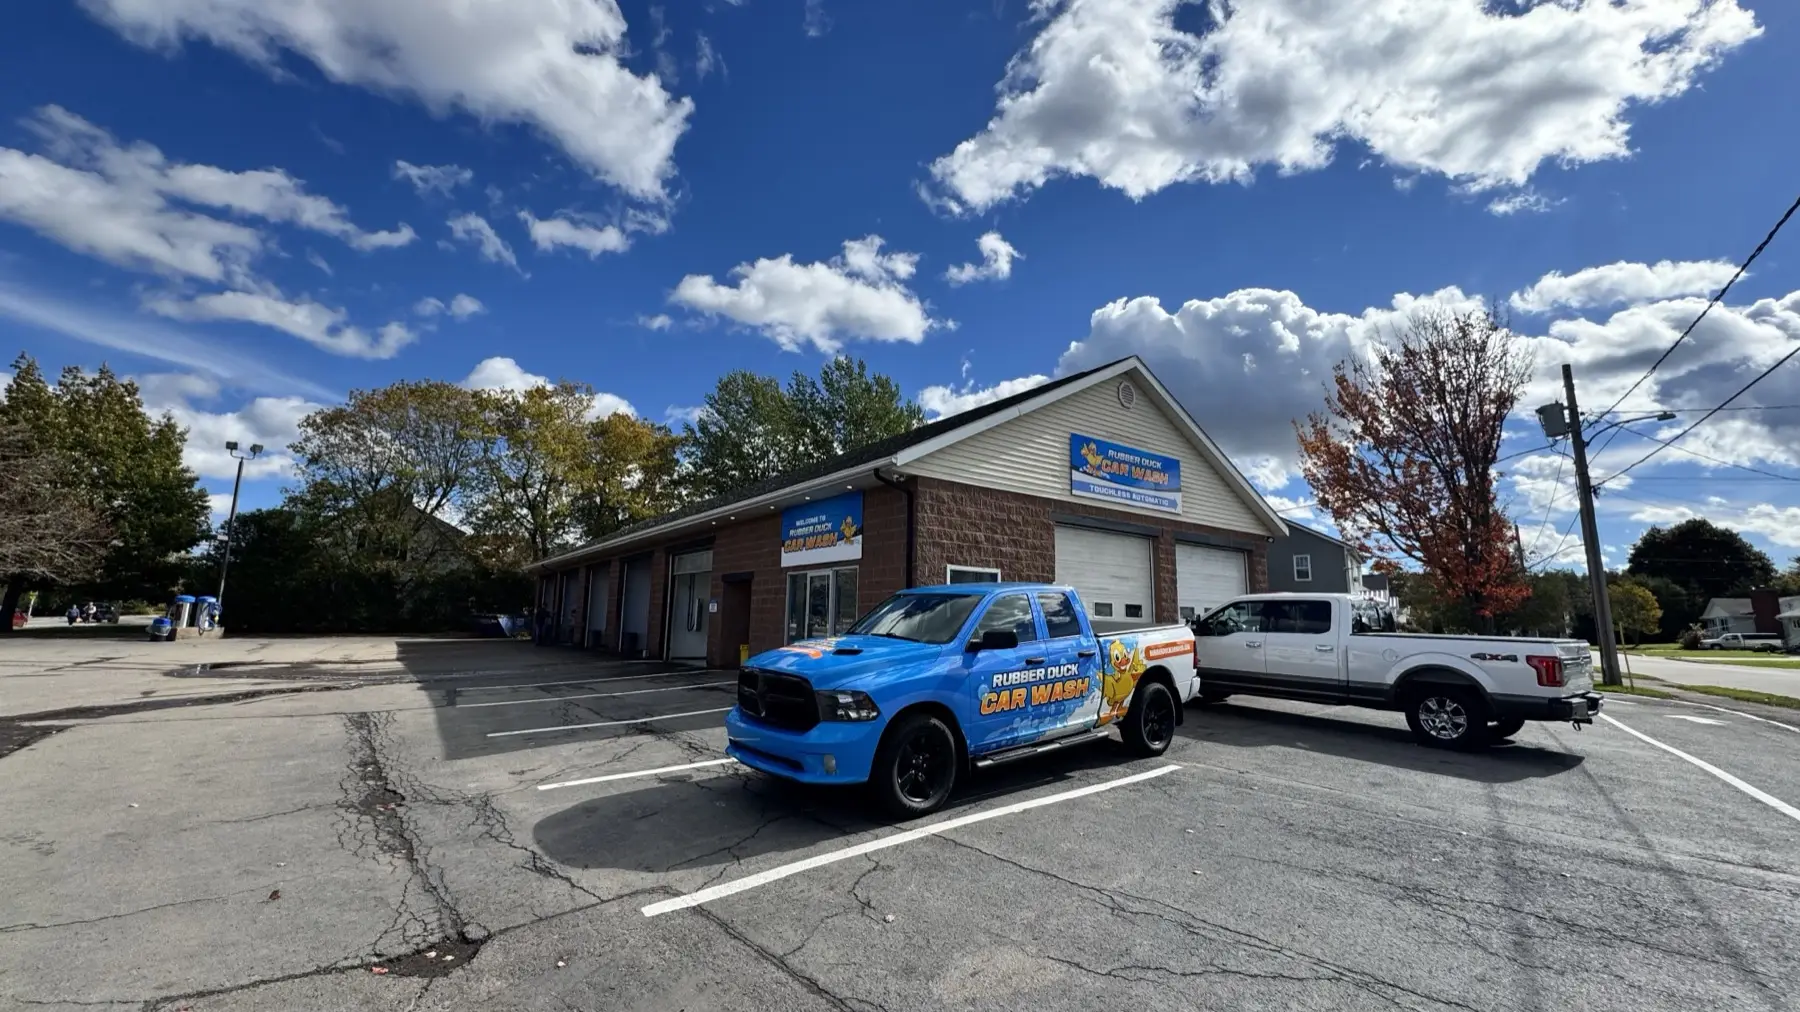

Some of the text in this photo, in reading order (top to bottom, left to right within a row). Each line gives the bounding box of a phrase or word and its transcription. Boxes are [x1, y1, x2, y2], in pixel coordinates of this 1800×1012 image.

[1108, 449, 1162, 470] RUBBER DUCK
[1101, 459, 1169, 485] CAR WASH
[1089, 484, 1169, 506] TOUCHLESS AUTOMATIC
[789, 522, 833, 537] RUBBER DUCK
[795, 514, 826, 527] WELCOME TO
[784, 532, 838, 553] CAR WASH
[992, 663, 1079, 688] RUBBER DUCK
[980, 677, 1090, 715] CAR WASH
